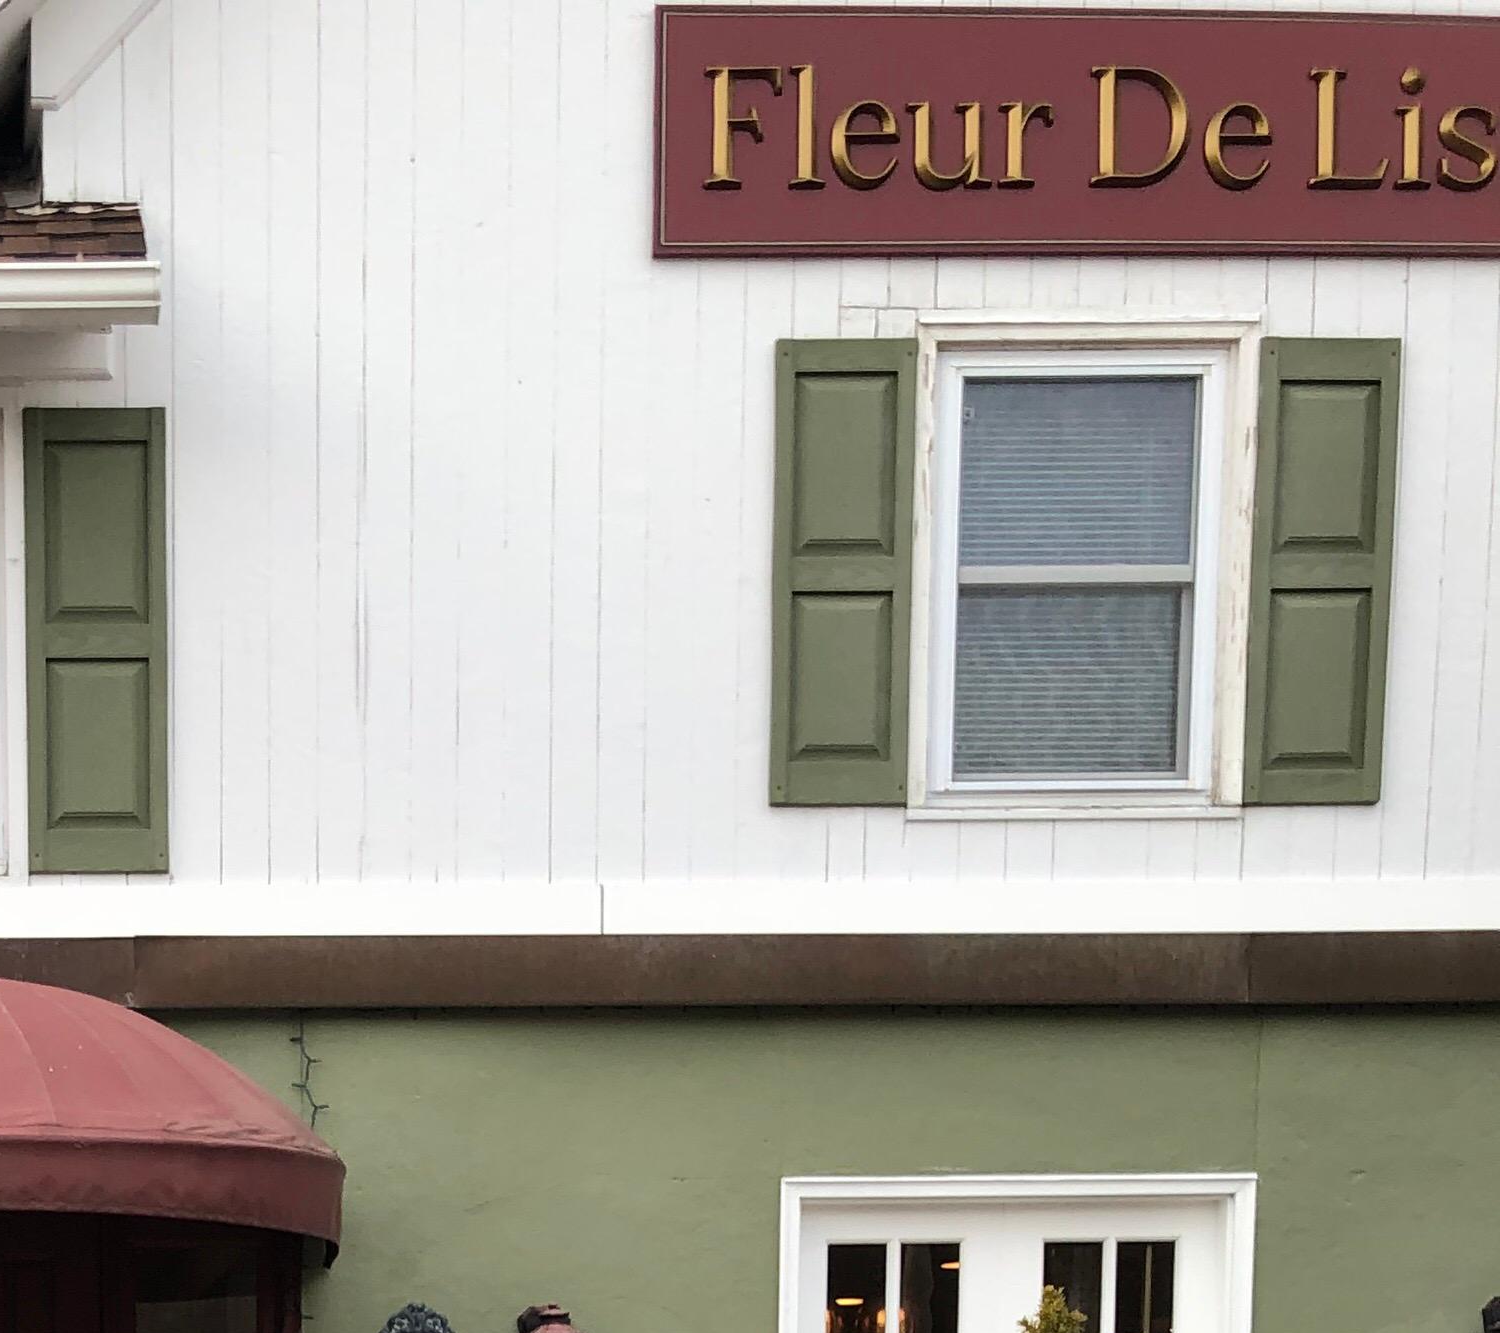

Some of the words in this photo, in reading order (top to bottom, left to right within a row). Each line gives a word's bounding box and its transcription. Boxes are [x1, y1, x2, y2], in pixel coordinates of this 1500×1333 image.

[702, 63, 1054, 193] Fleur
[1088, 65, 1273, 193] De
[1305, 65, 1497, 193] Lis
